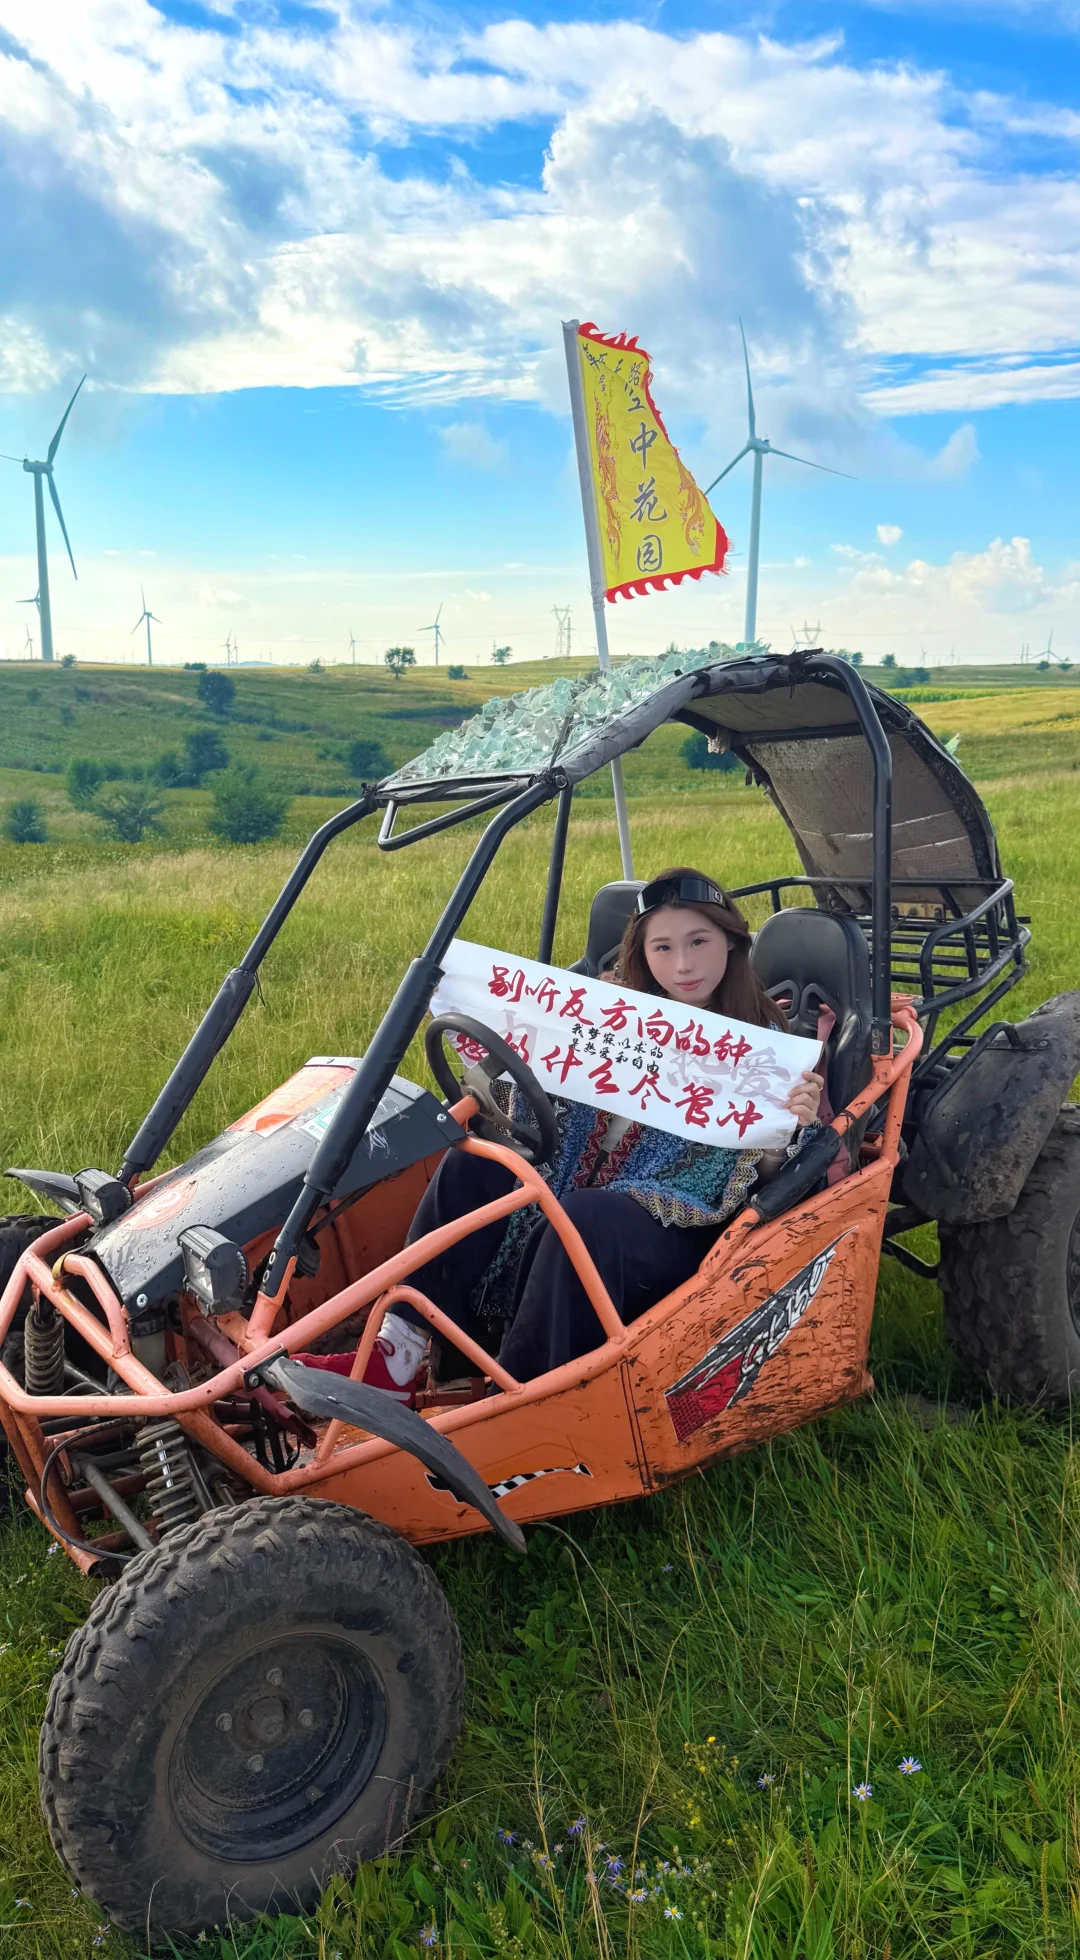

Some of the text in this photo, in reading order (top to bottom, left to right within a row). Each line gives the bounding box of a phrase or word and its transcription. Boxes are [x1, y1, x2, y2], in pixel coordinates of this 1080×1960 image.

[624, 382, 667, 573] 空中花园
[487, 964, 753, 1067] 别听反方向的钟
[571, 1023, 664, 1059] 我梦寐以求的
[571, 1038, 660, 1074] 是热爱和自由
